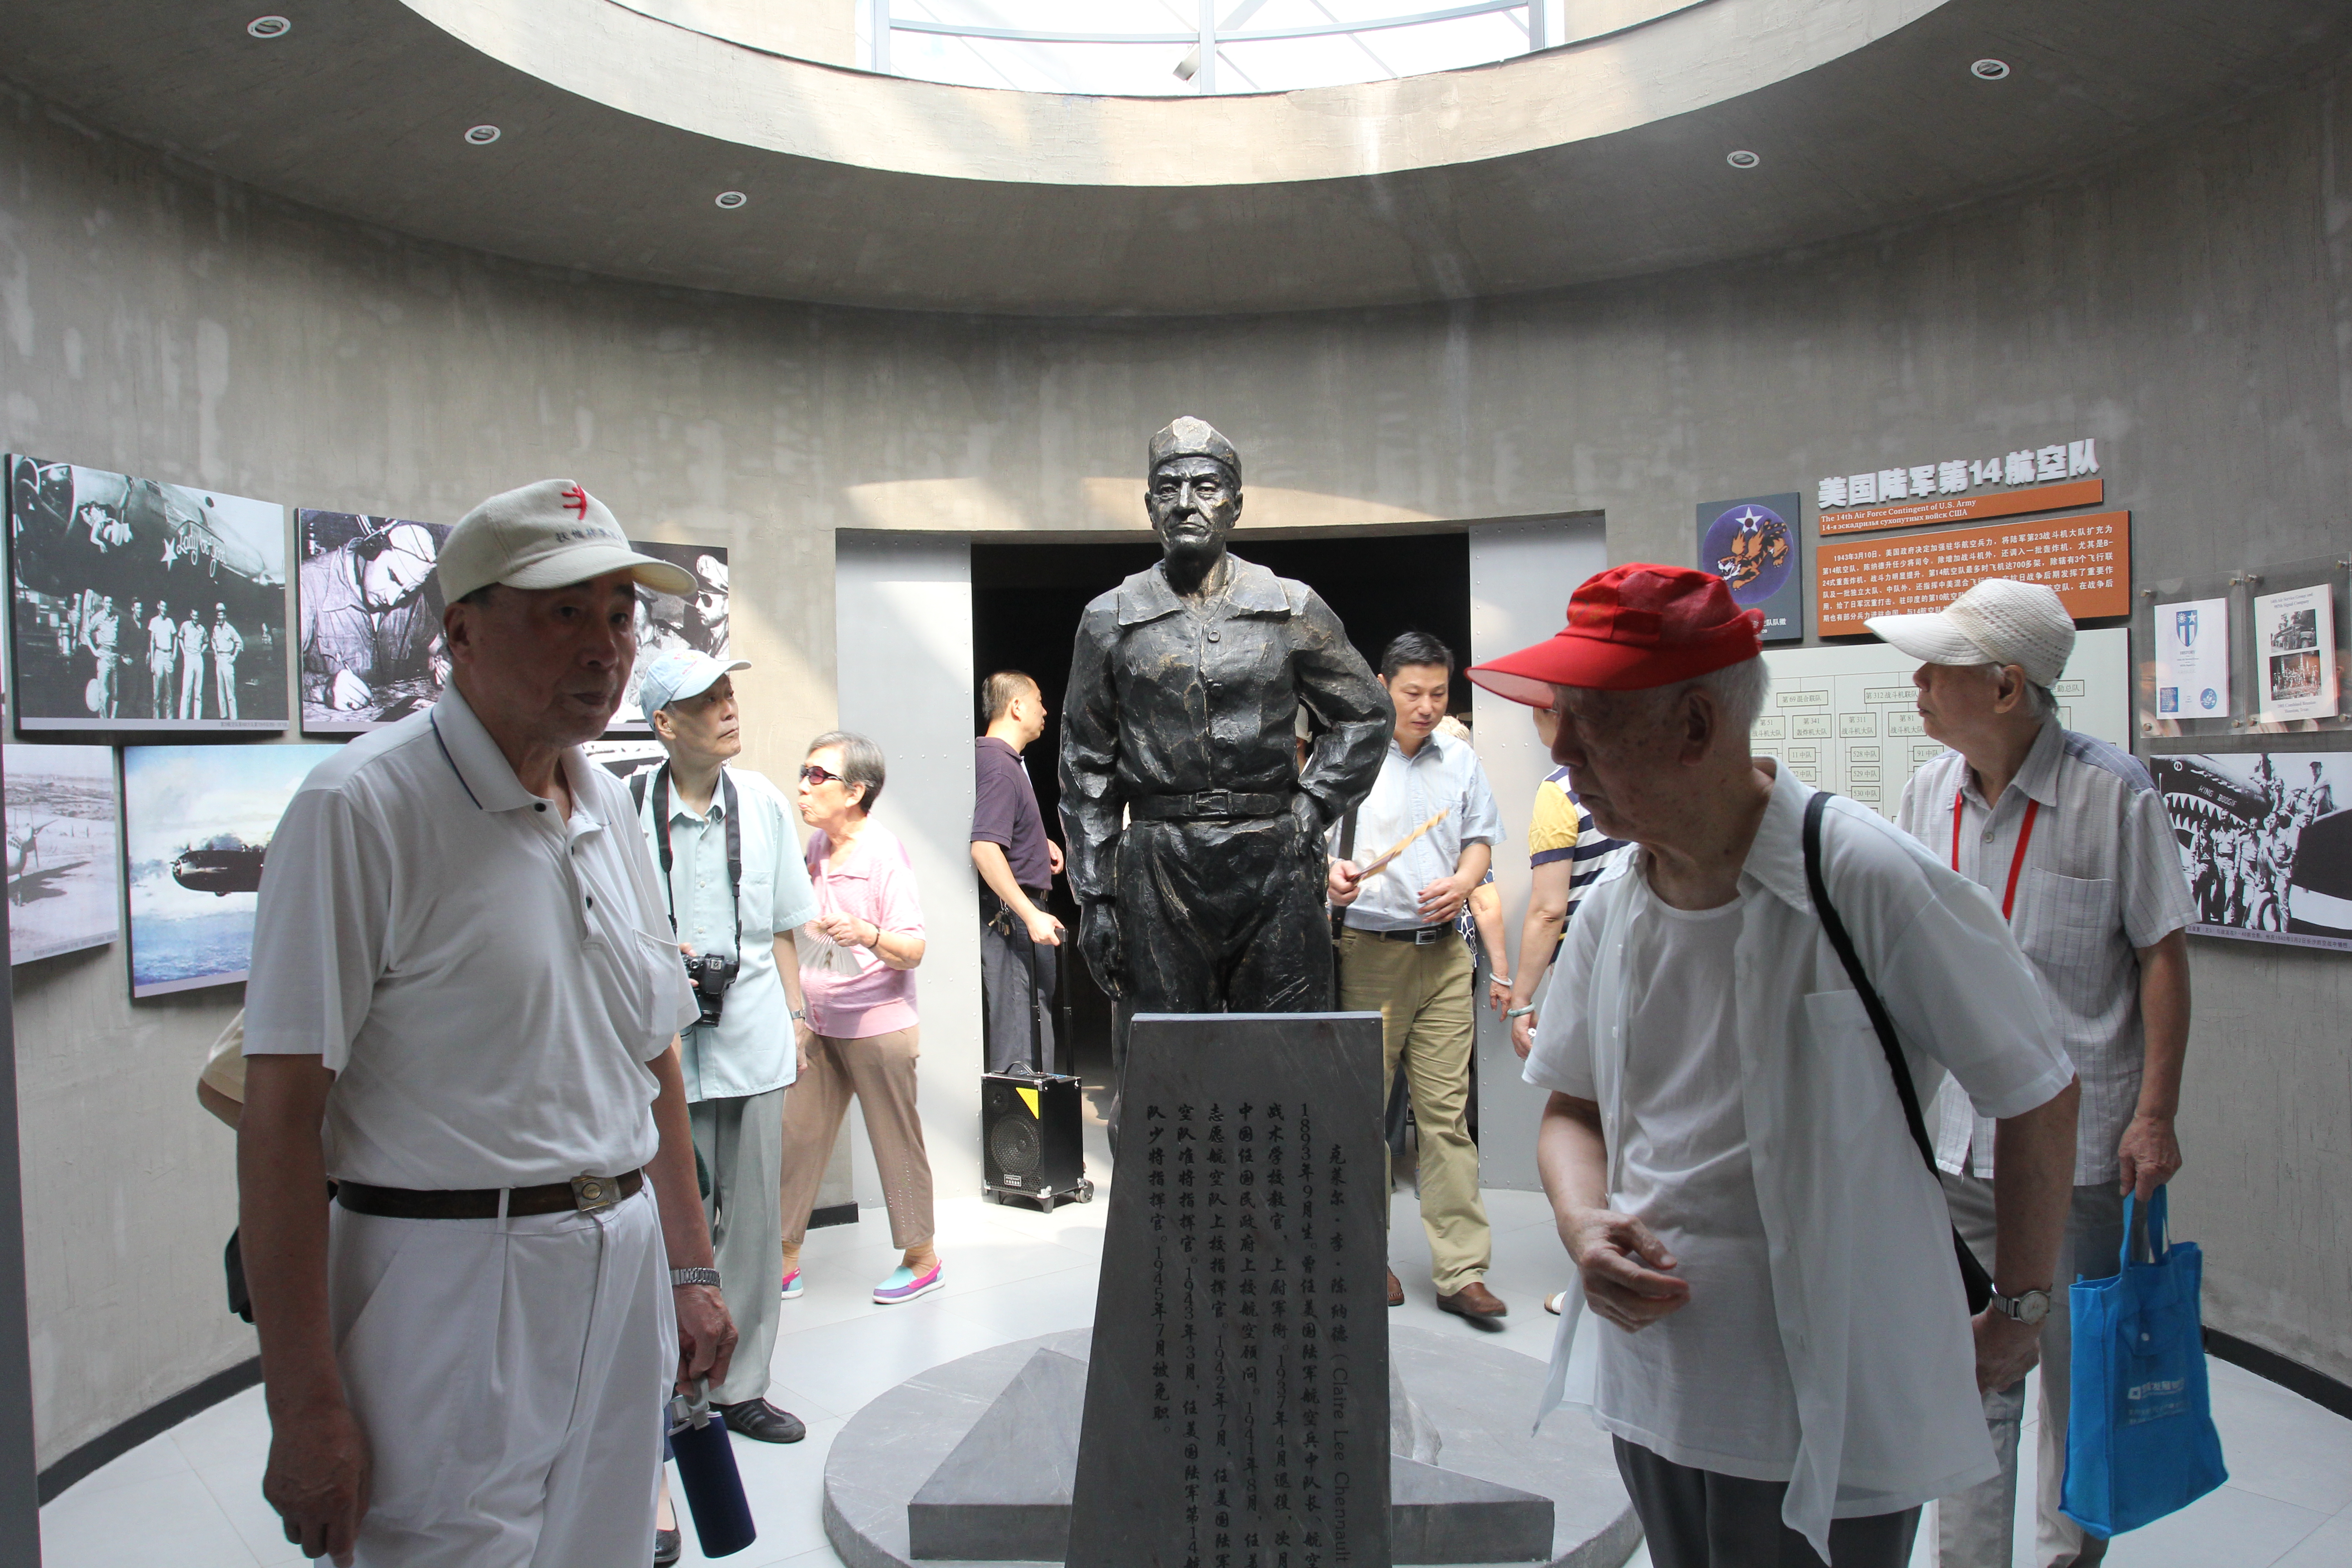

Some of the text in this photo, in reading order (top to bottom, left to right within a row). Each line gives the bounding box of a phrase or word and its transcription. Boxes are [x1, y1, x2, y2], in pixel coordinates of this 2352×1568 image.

[1818, 439, 2099, 509] 美国陆军第14航空队
[1867, 510, 1886, 518] Force
[1888, 506, 1929, 516] Contingent
[1956, 499, 1976, 509] Army
[1822, 523, 1837, 531] 14-я
[1838, 520, 1879, 529] эскадрилья
[1880, 515, 1924, 525] сухопутных
[176, 523, 198, 566] Lady
[199, 528, 210, 555] be
[1842, 726, 1874, 735] 战斗机大队
[2198, 785, 2237, 807] KING BOOGIE
[1333, 1430, 1349, 1462] Lee
[1333, 1471, 1350, 1562] Chennault
